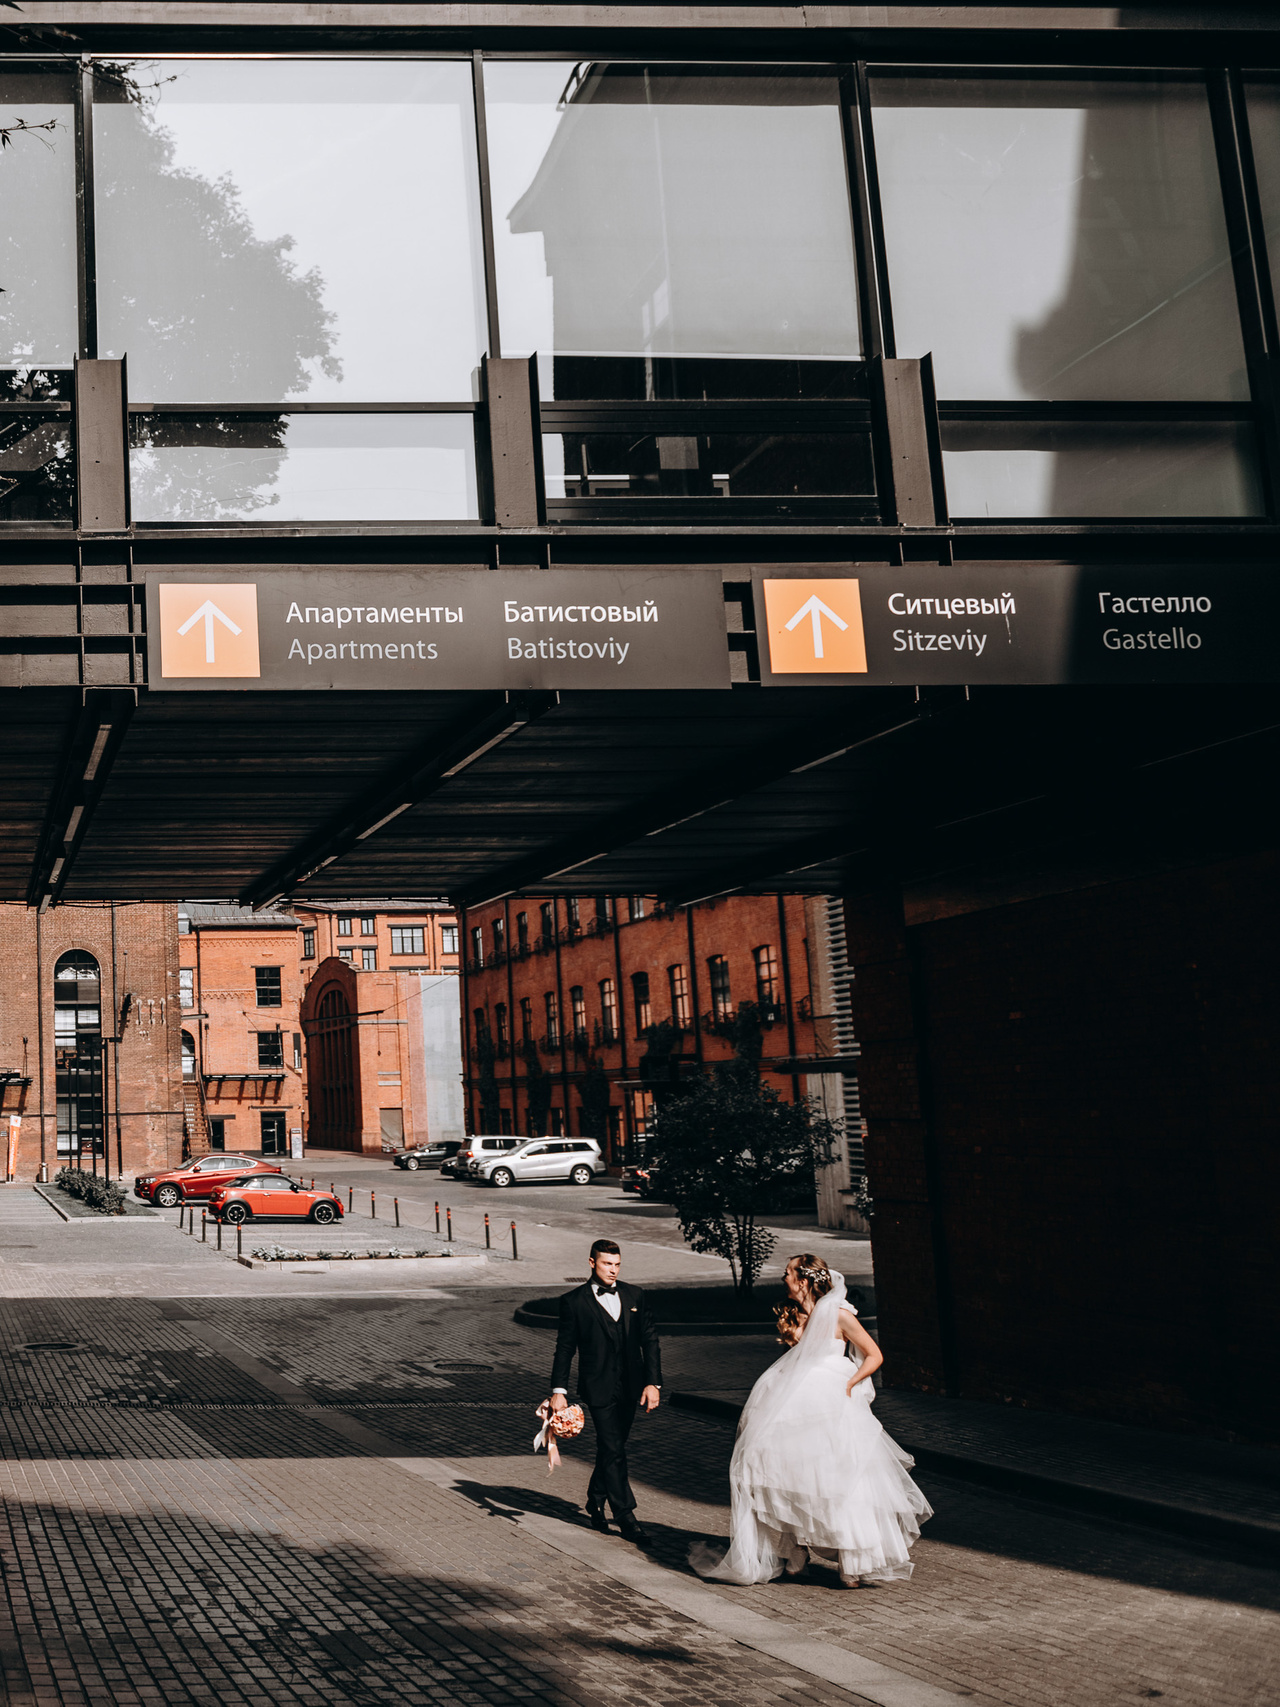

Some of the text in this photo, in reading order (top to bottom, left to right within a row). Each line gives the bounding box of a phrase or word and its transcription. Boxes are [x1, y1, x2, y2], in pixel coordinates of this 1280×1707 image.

[286, 601, 464, 628] Апартаменты
[504, 600, 659, 623] Батистовый
[888, 592, 1016, 618] Ситцевый
[1099, 592, 1212, 614] Гастелло
[288, 638, 438, 665] Apartments
[507, 637, 630, 665] Batistoviy
[893, 629, 988, 656] Sitzeviy
[1103, 627, 1202, 650] Gastello
